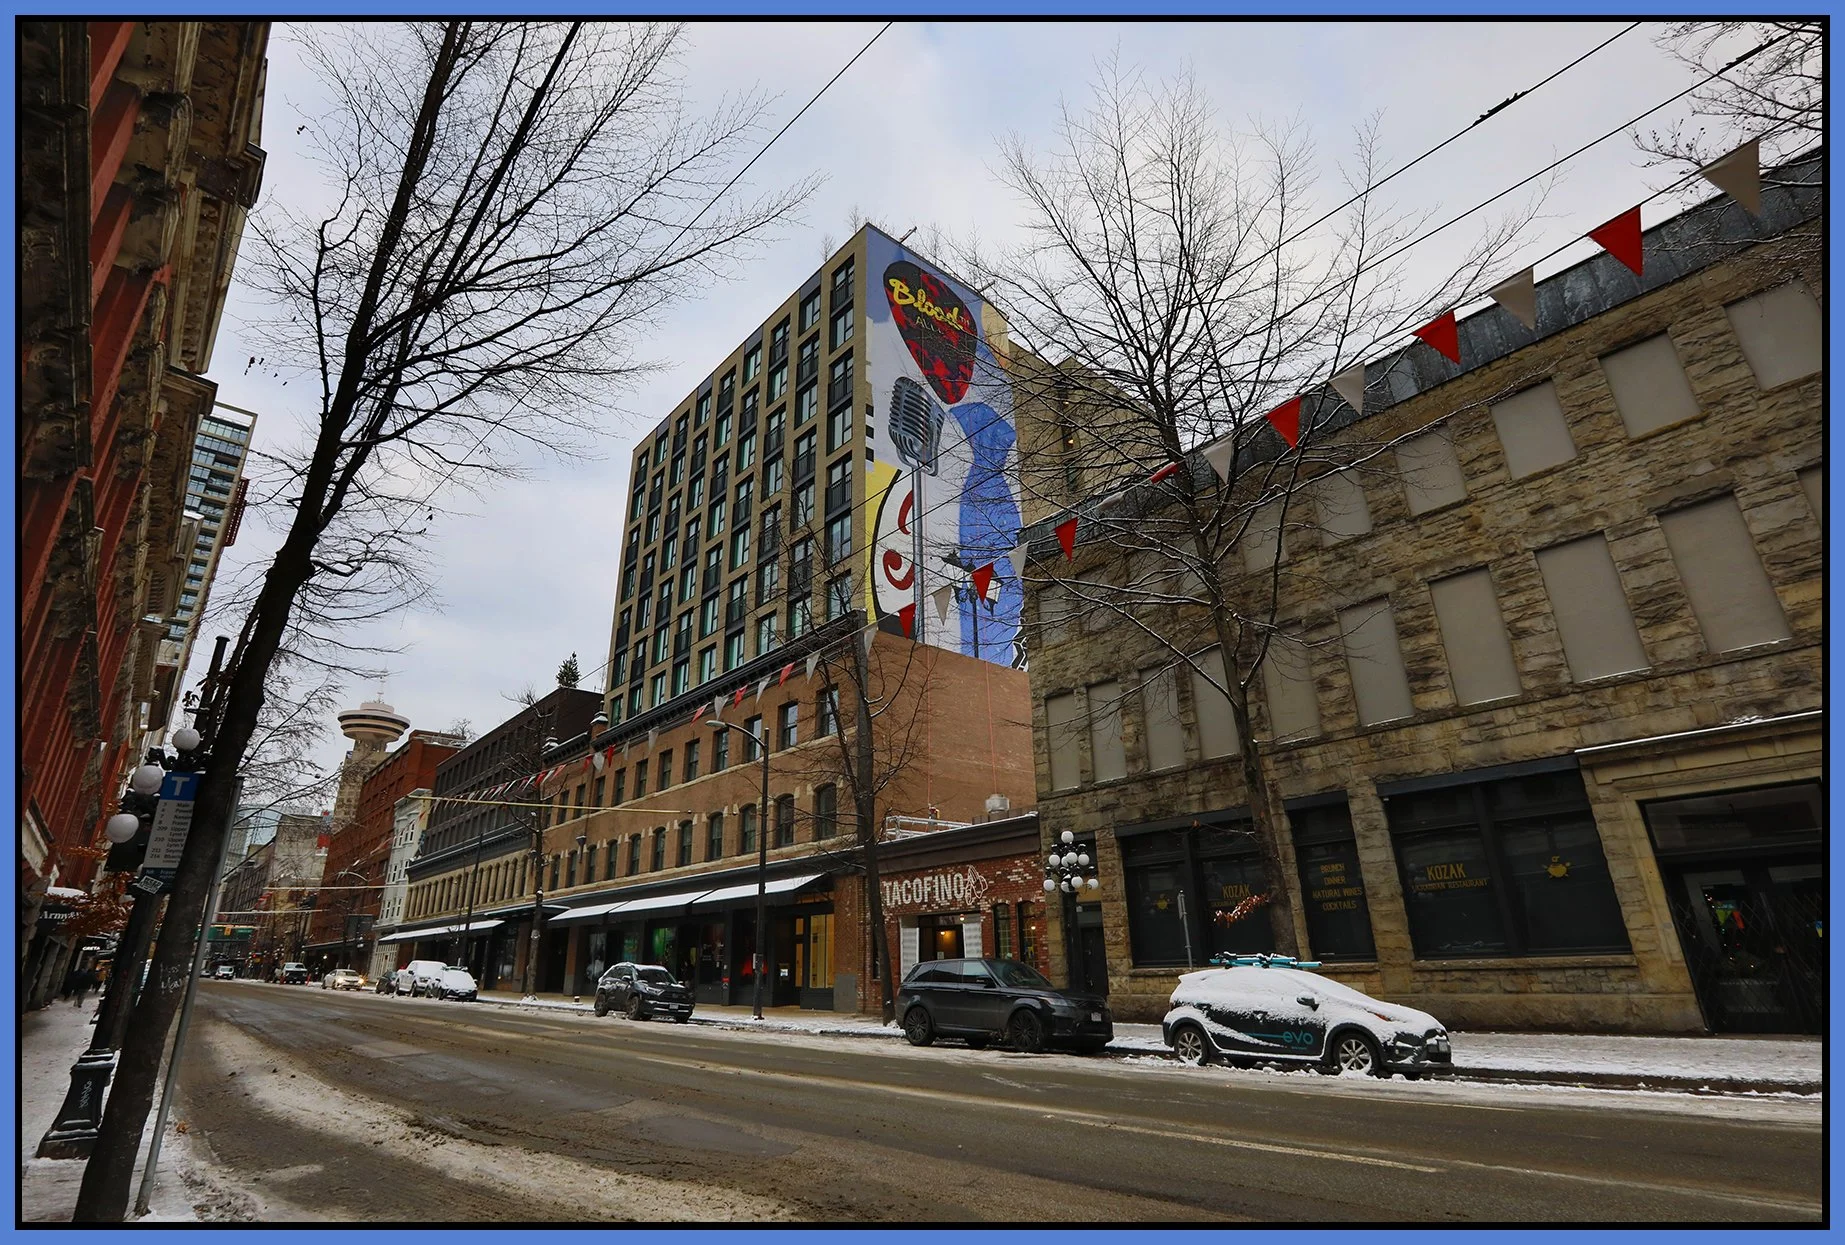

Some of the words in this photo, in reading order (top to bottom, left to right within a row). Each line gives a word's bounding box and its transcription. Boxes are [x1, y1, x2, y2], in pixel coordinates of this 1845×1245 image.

[889, 278, 963, 331] Blood
[171, 776, 190, 796] T
[1320, 863, 1345, 873] BRUNCH
[1426, 863, 1466, 880] KOZAK
[1323, 875, 1345, 886] DINNER
[882, 872, 964, 906] TACOFINO
[1222, 884, 1250, 899] KOZAK
[1312, 888, 1341, 899] NATURAL
[1343, 887, 1363, 897] WINES
[1322, 900, 1357, 911] COCKTAILS
[1283, 1031, 1313, 1045] evo
